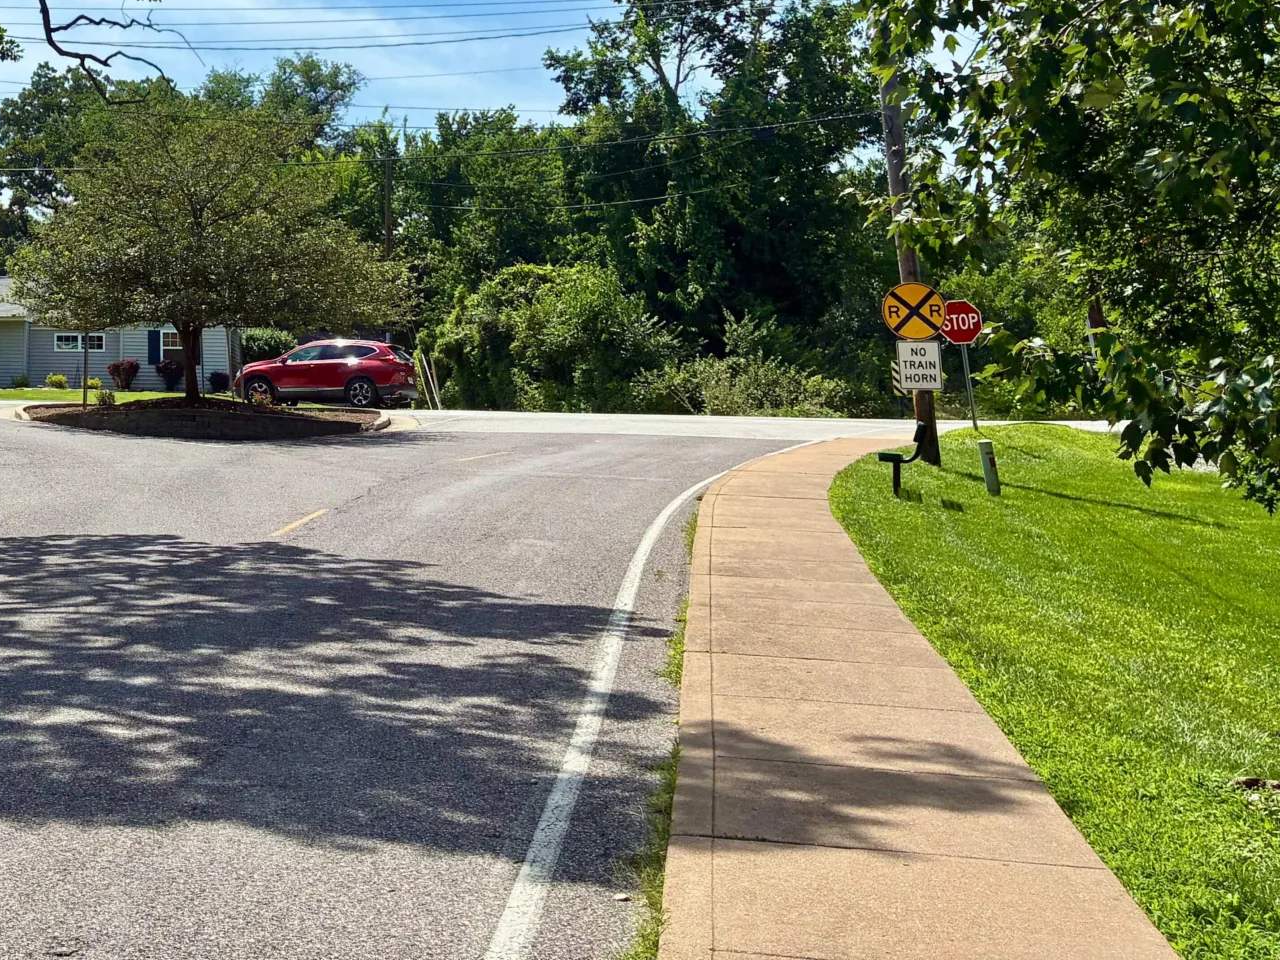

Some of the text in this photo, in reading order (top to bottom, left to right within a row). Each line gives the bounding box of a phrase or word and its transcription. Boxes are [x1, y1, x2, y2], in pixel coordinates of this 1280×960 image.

[888, 304, 942, 319] R R
[943, 313, 978, 331] STOP
[910, 347, 926, 357] NO
[902, 360, 936, 370] TRAIN
[904, 373, 937, 383] HORN
